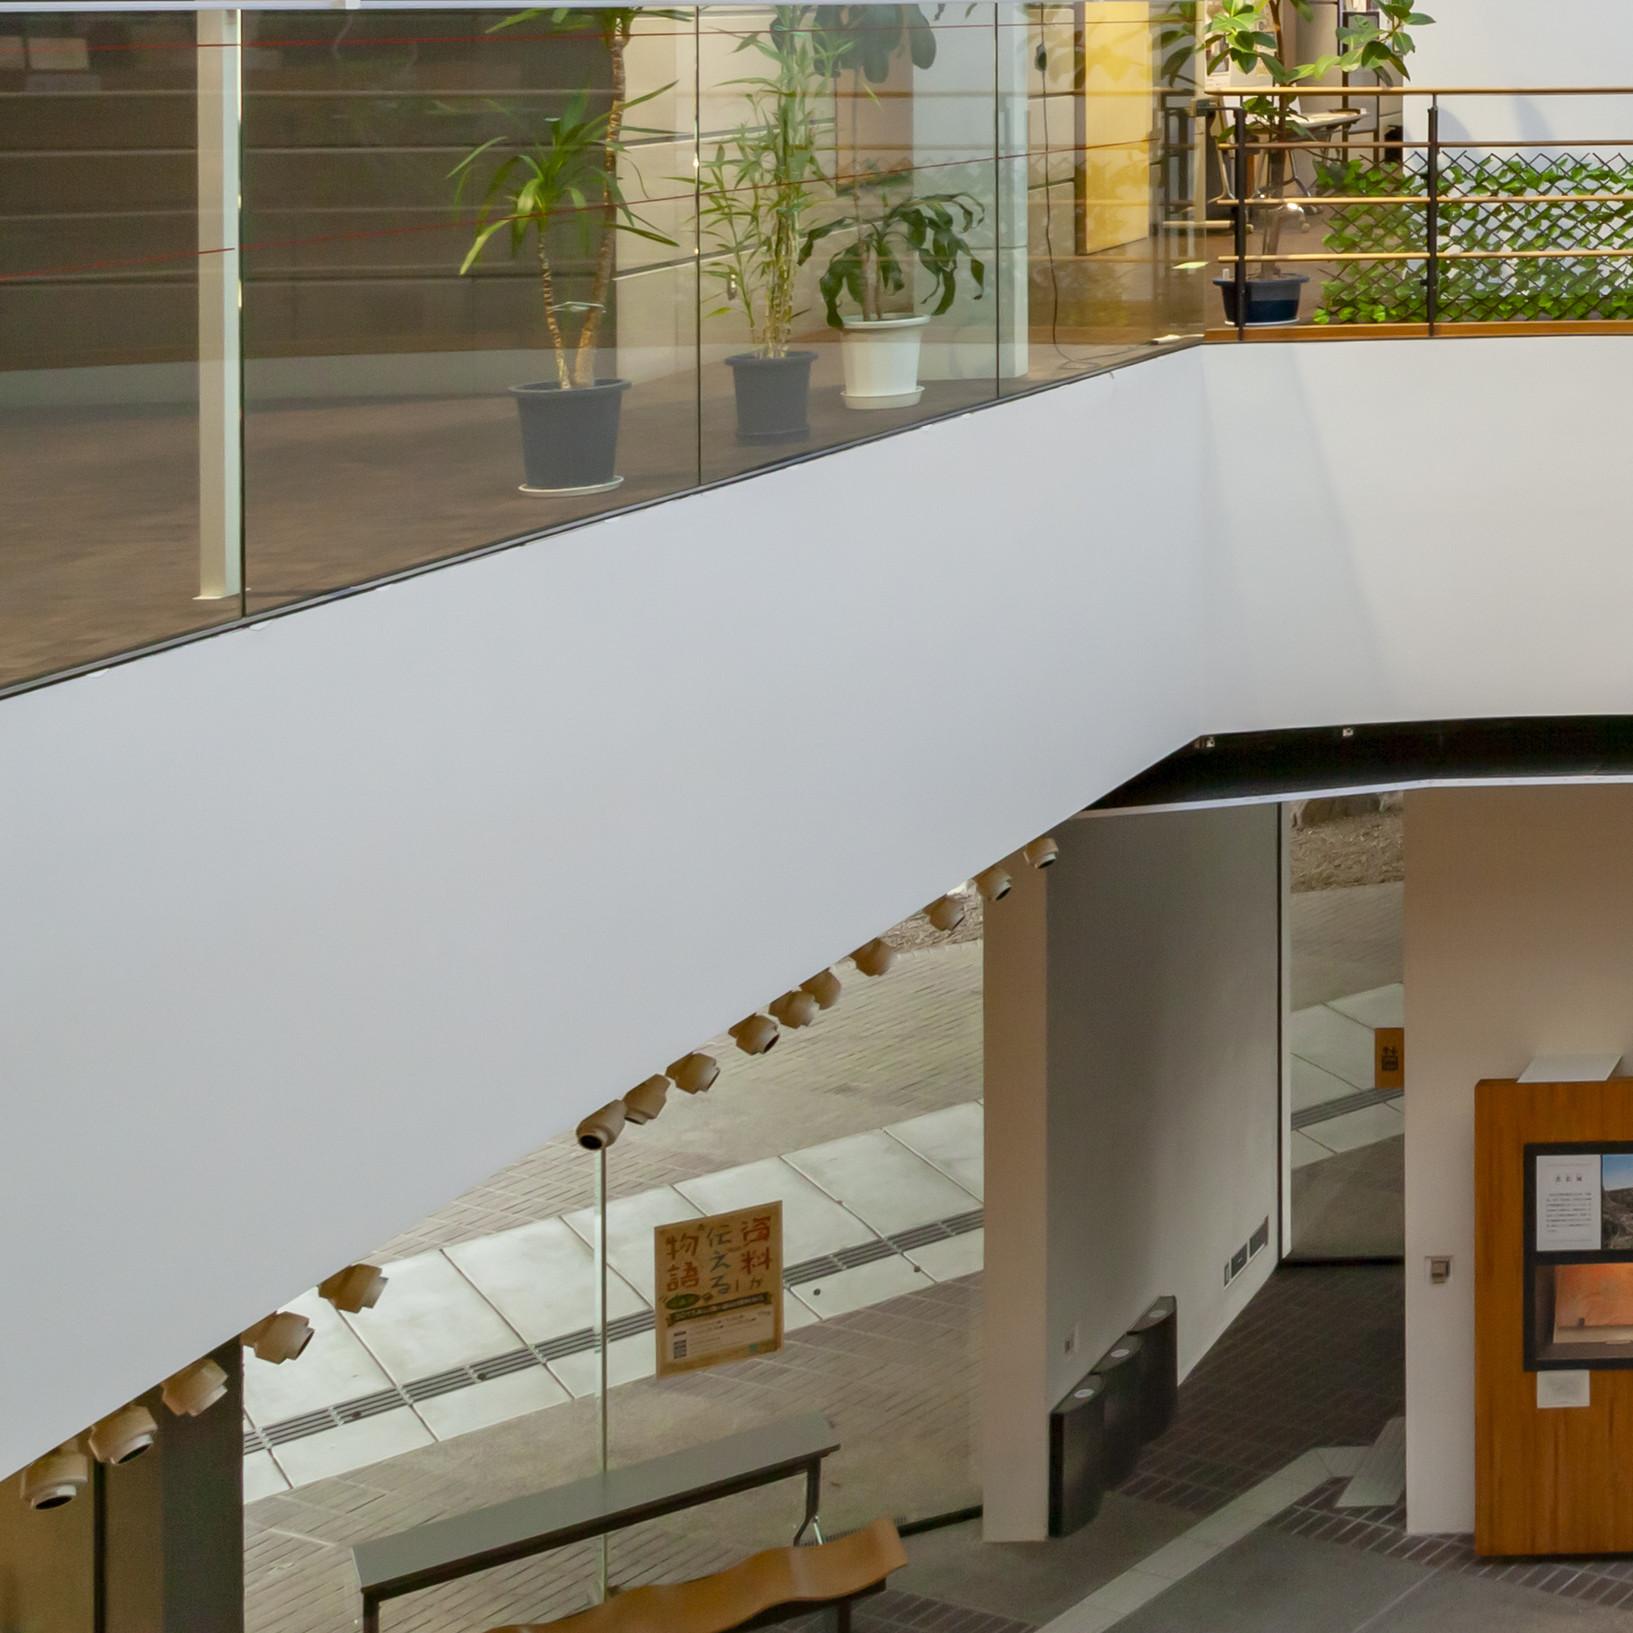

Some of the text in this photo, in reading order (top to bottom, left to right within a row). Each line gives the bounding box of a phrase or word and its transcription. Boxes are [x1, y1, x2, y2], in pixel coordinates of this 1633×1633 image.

[665, 1232, 701, 1292] 物語
[706, 1225, 732, 1295] 伝える
